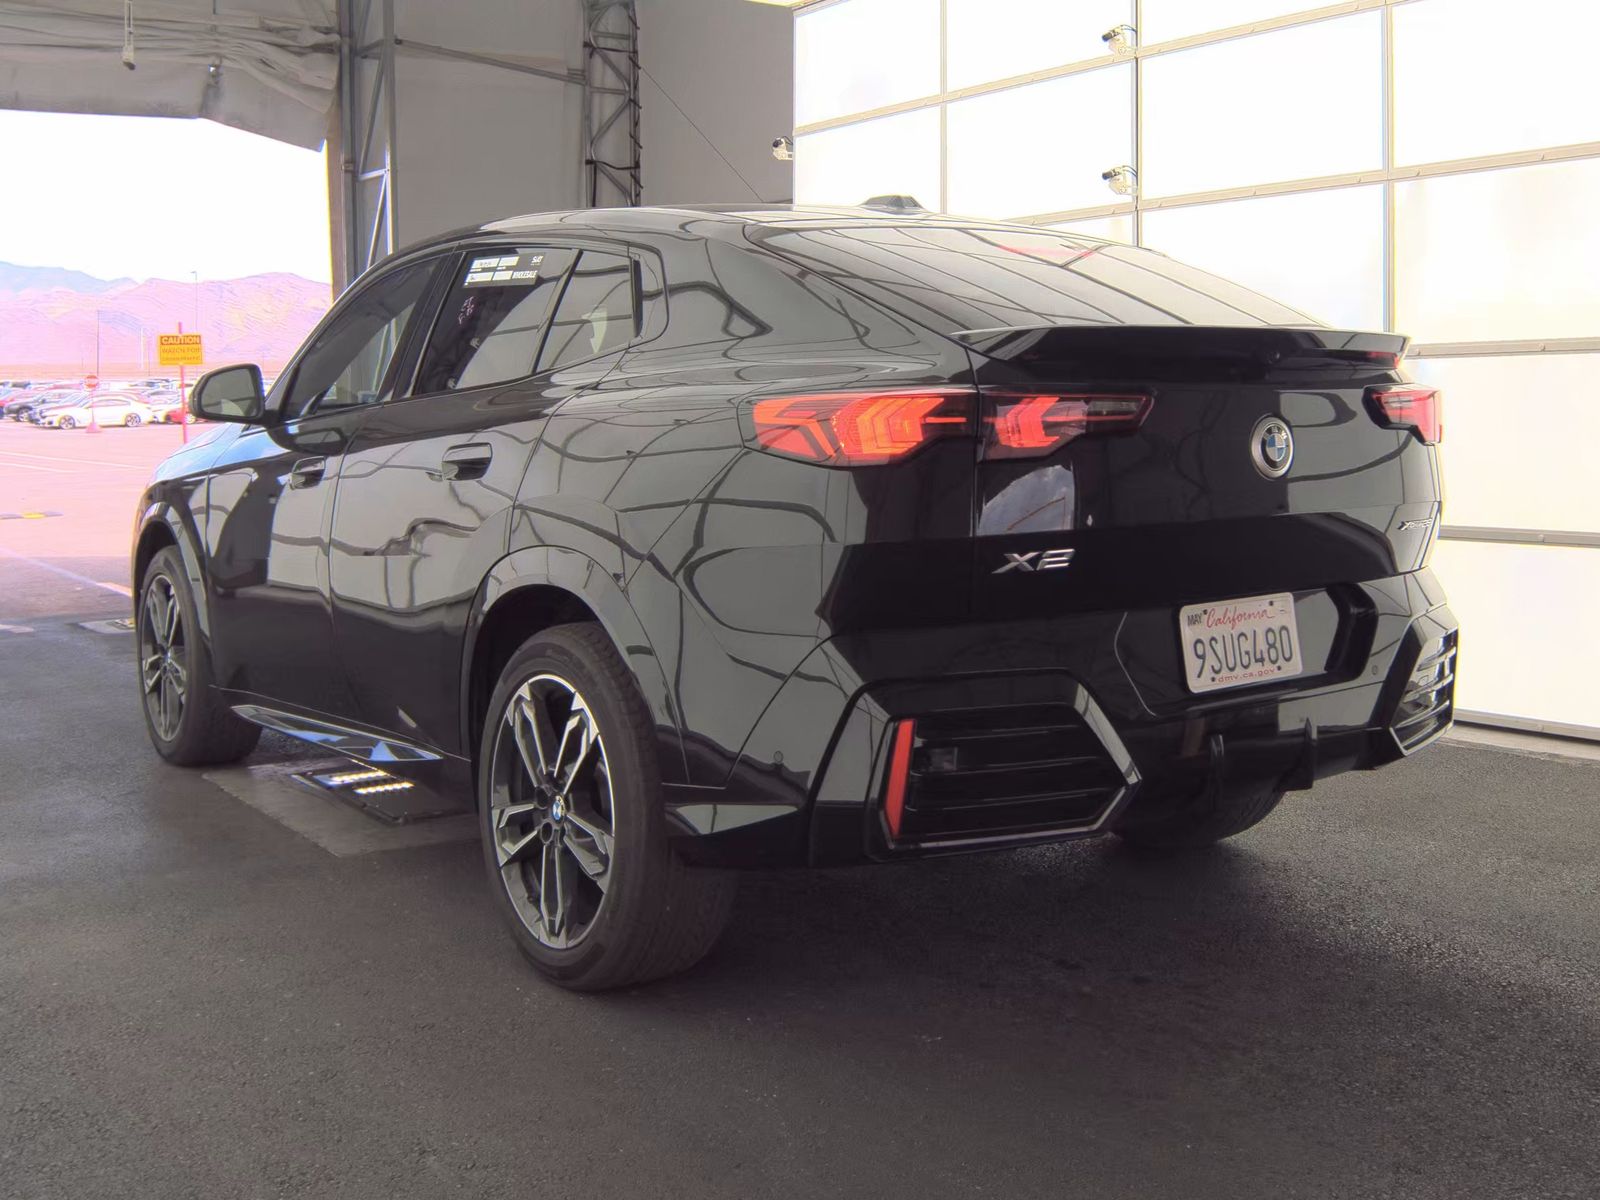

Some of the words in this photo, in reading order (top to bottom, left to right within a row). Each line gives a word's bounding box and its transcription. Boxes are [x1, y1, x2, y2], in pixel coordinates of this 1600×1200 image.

[162, 336, 200, 345] CAUTION
[991, 548, 1075, 575] X2
[1187, 613, 1202, 627] MAY
[1206, 606, 1275, 630] California
[1193, 625, 1293, 679] 9SUG480
[1217, 667, 1276, 683] dmv.ca.gov
